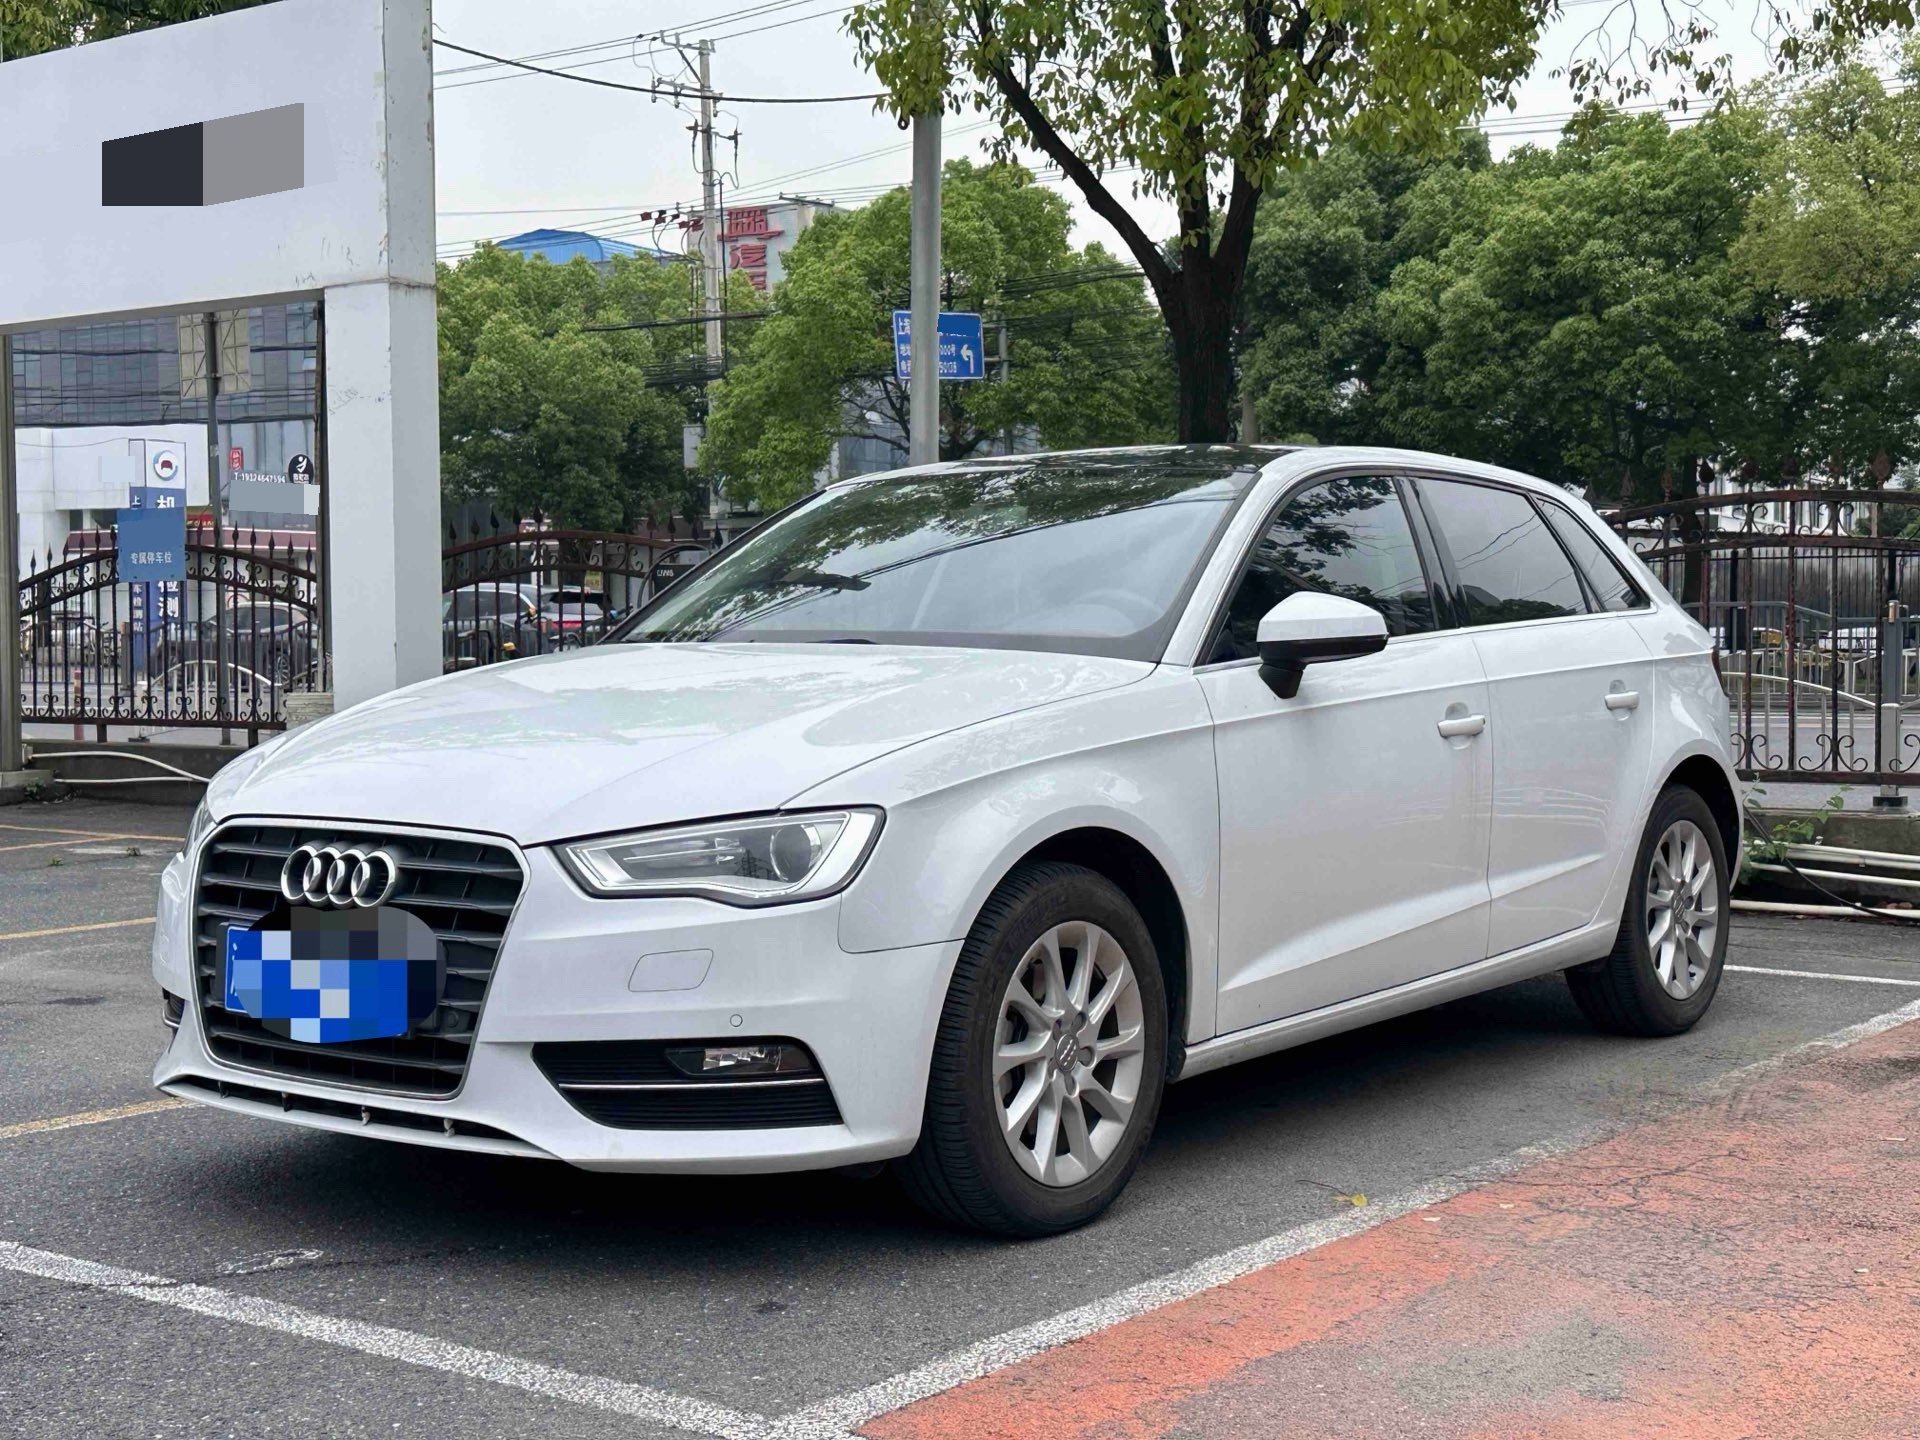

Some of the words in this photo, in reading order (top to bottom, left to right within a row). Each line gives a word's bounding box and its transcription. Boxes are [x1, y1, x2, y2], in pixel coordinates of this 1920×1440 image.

[130, 551, 173, 565] 专属停车位
